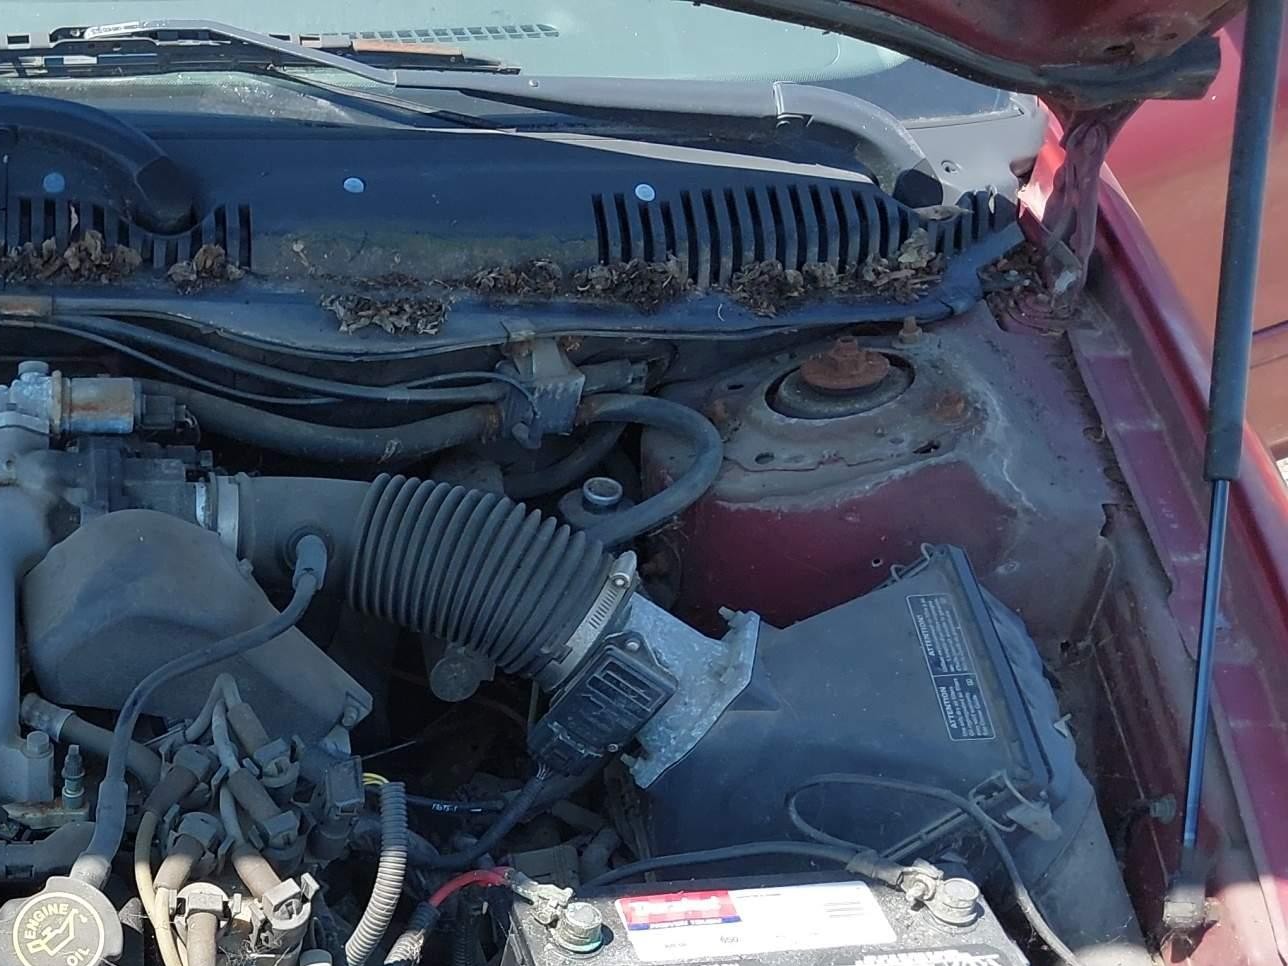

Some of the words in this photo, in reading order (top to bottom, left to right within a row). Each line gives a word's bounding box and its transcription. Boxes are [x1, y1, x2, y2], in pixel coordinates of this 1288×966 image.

[939, 686, 958, 729] ATTENTION
[24, 903, 69, 939] ENGINE
[66, 947, 91, 966] OIL
